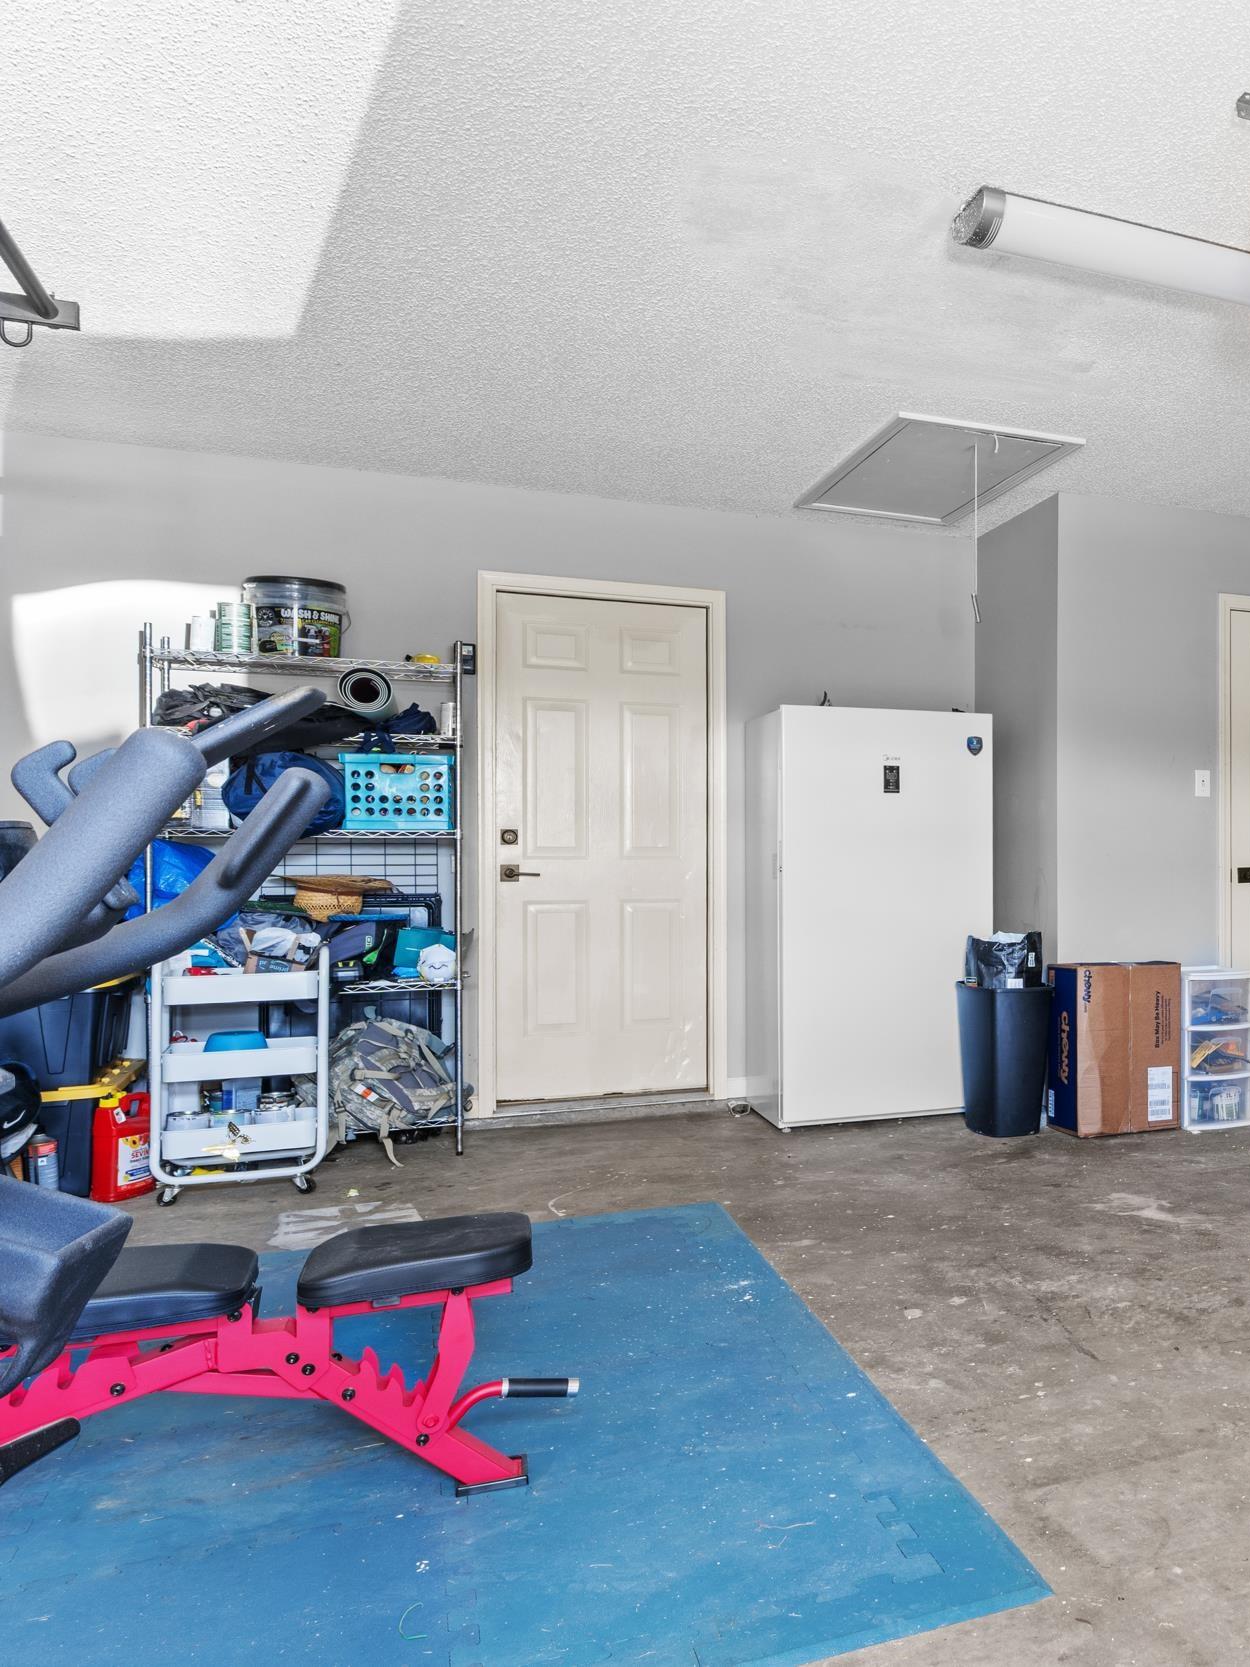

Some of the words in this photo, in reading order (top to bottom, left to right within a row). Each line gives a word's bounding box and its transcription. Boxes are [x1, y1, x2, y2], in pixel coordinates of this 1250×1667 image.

[312, 610, 320, 620] &
[1082, 969, 1092, 1003] chewy
[1061, 1011, 1070, 1085] chewy
